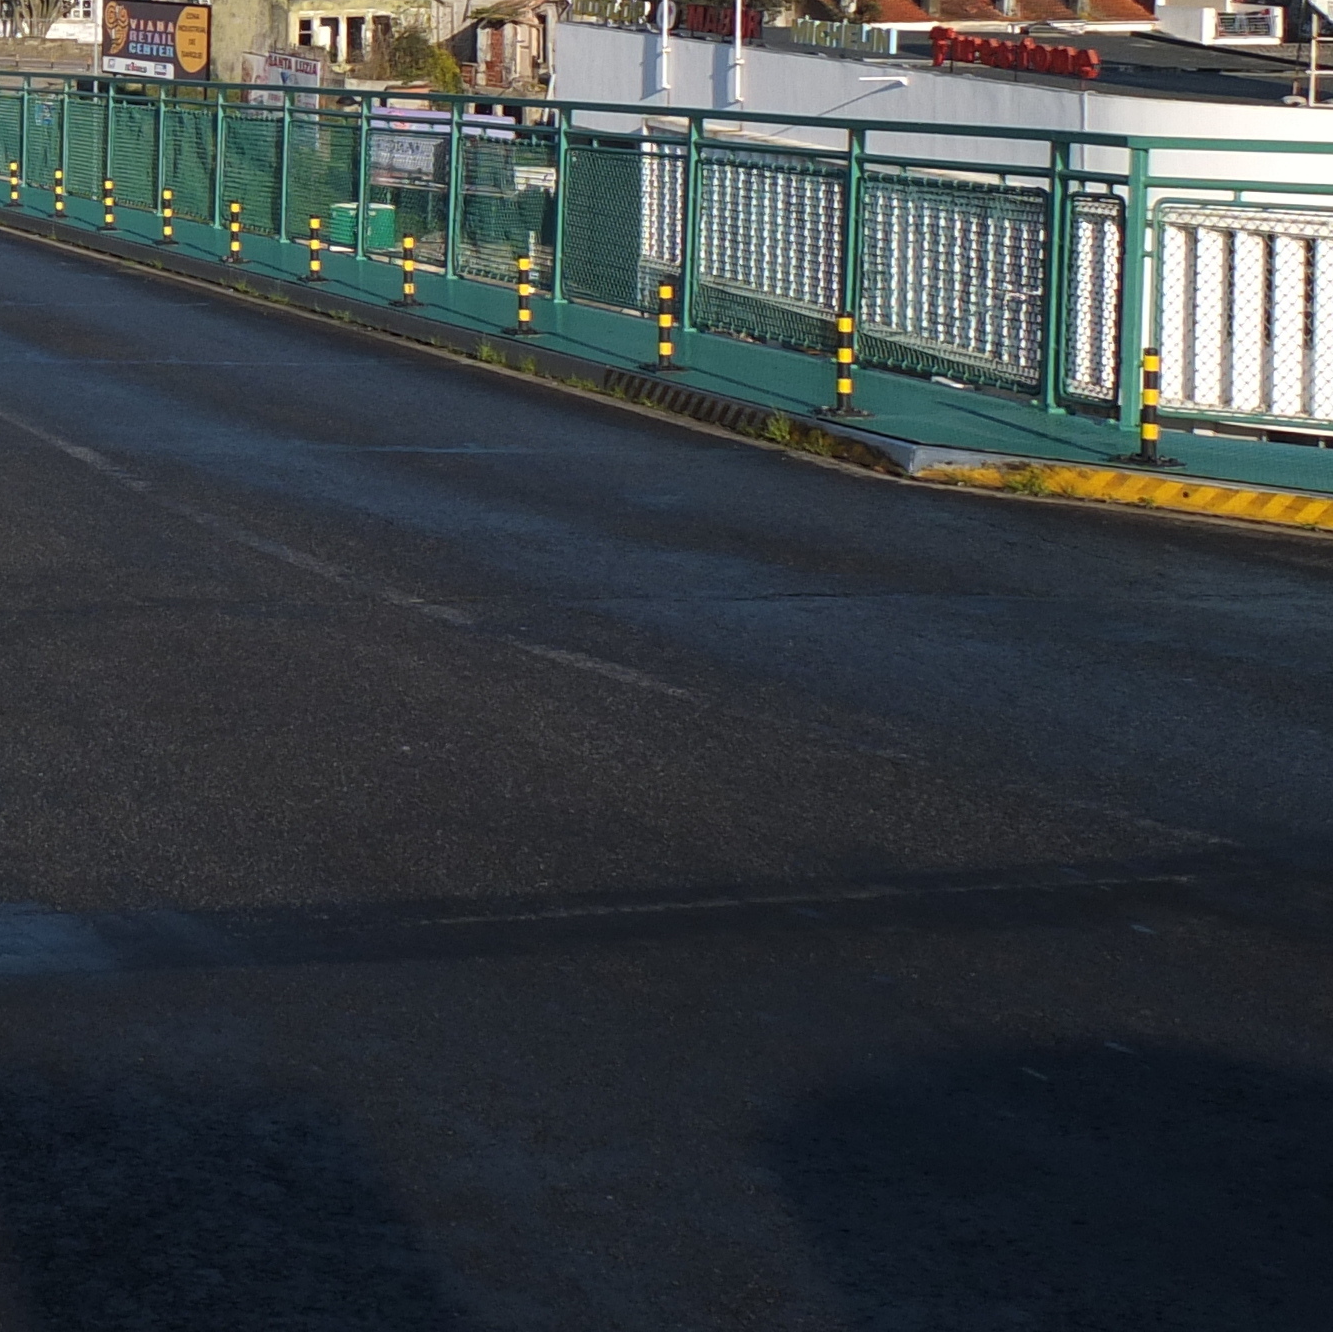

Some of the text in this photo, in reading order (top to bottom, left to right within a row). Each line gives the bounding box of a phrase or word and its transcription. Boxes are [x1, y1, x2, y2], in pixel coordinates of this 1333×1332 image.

[129, 18, 175, 33] VIANA
[129, 30, 175, 46] RETAIL
[793, 16, 898, 55] MICHELIN
[128, 42, 175, 58] CENTER
[266, 54, 318, 76] SANTA LUZIA
